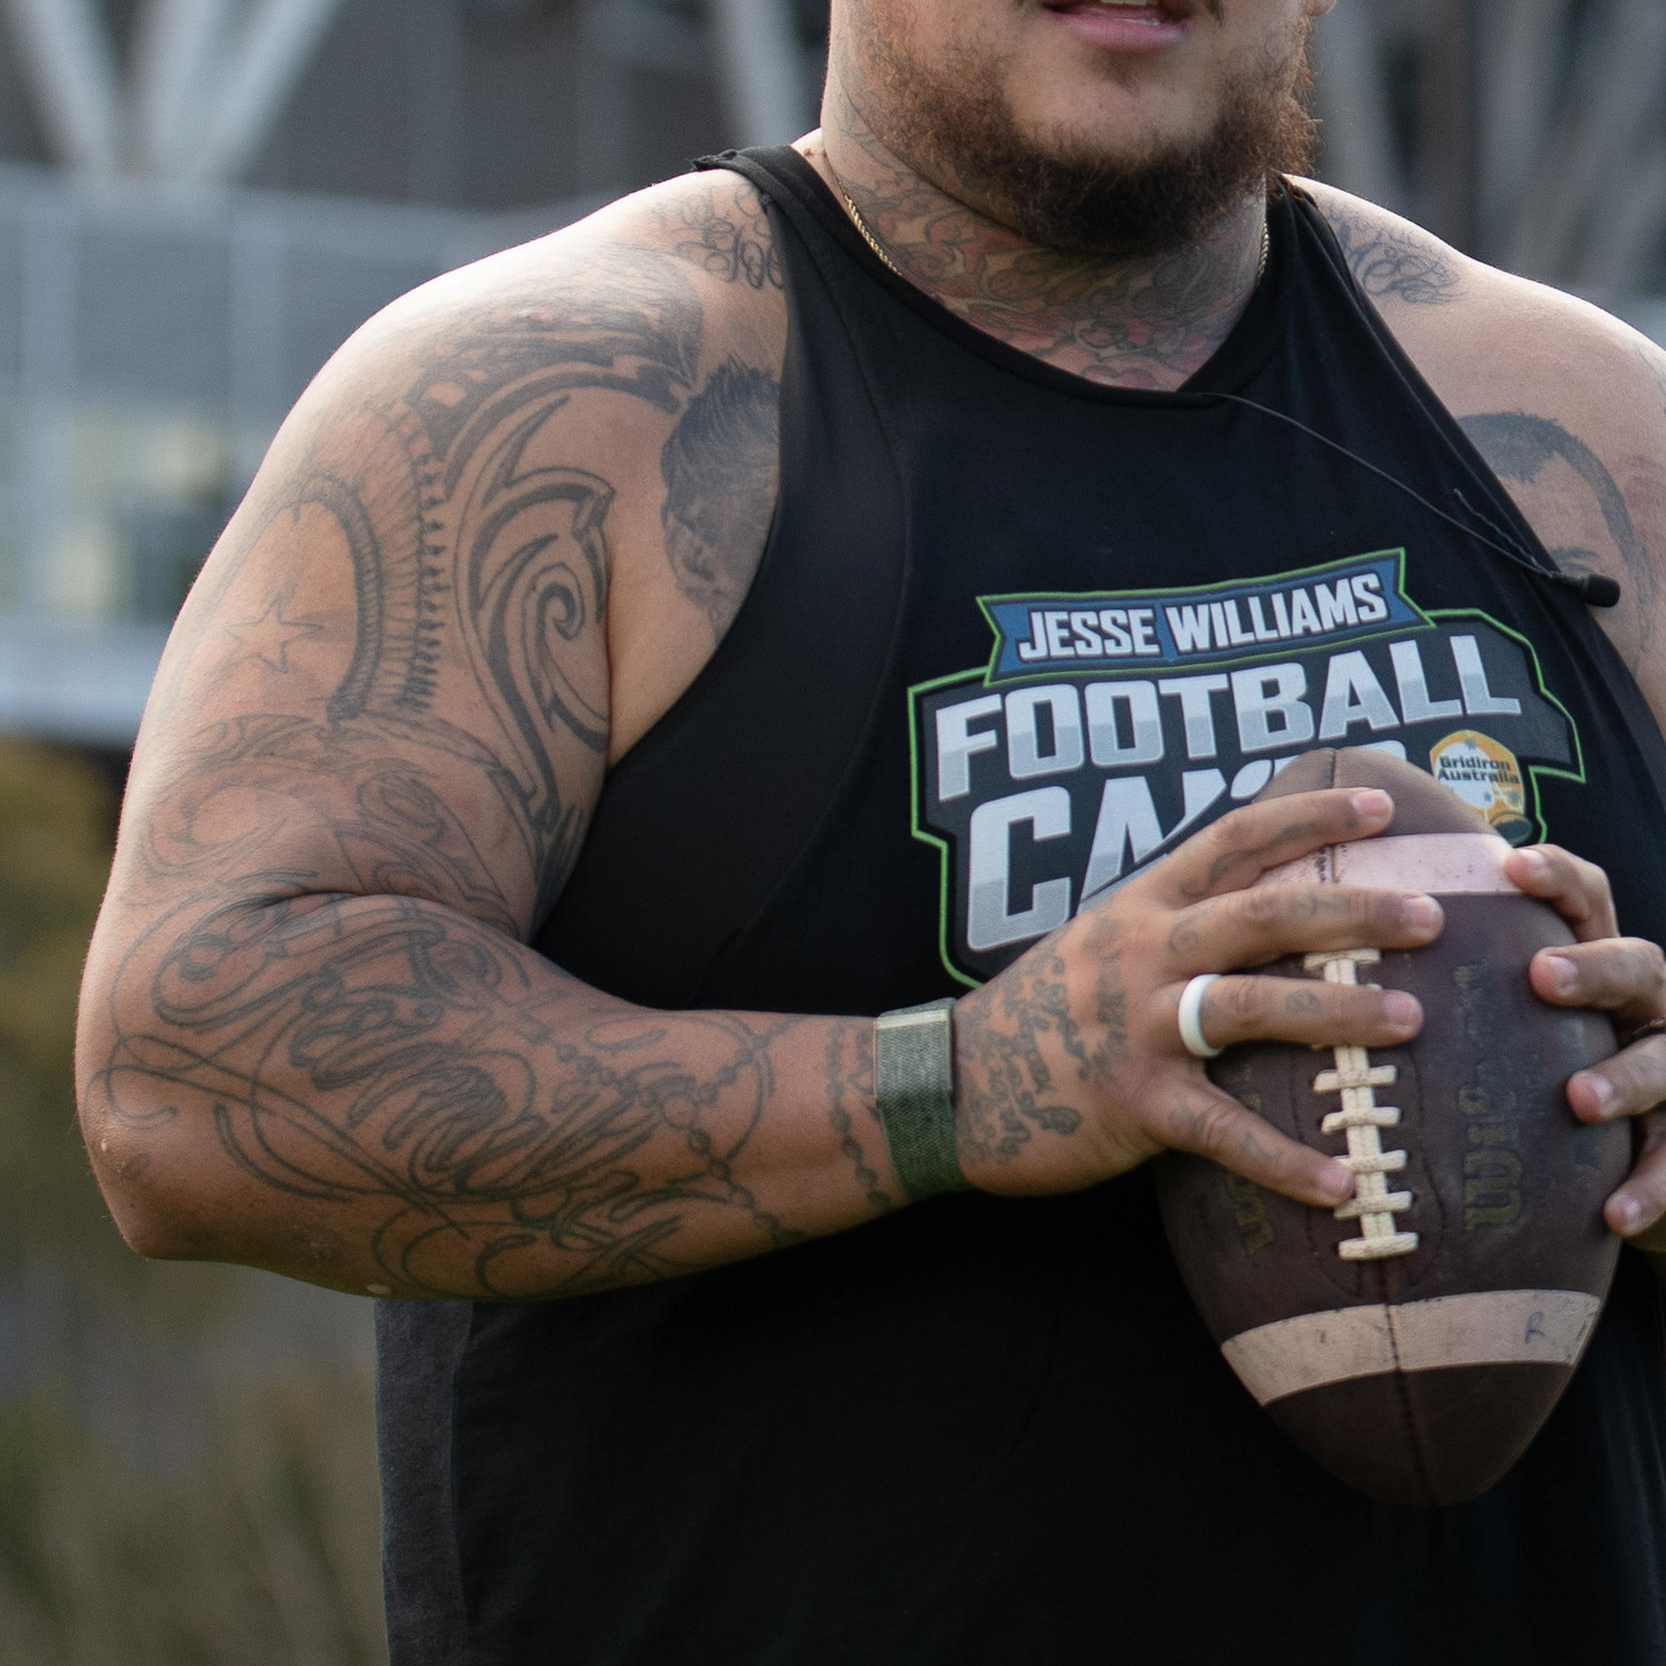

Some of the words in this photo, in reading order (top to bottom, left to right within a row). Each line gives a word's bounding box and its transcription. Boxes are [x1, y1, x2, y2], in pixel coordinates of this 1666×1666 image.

[1018, 610, 1160, 661] JESSE
[1166, 572, 1389, 652] WILLIAMS
[937, 634, 1522, 802] FOOTBALL
[1437, 768, 1519, 784] Australia
[1439, 755, 1511, 771] Gridiron
[966, 739, 1408, 952] CA
